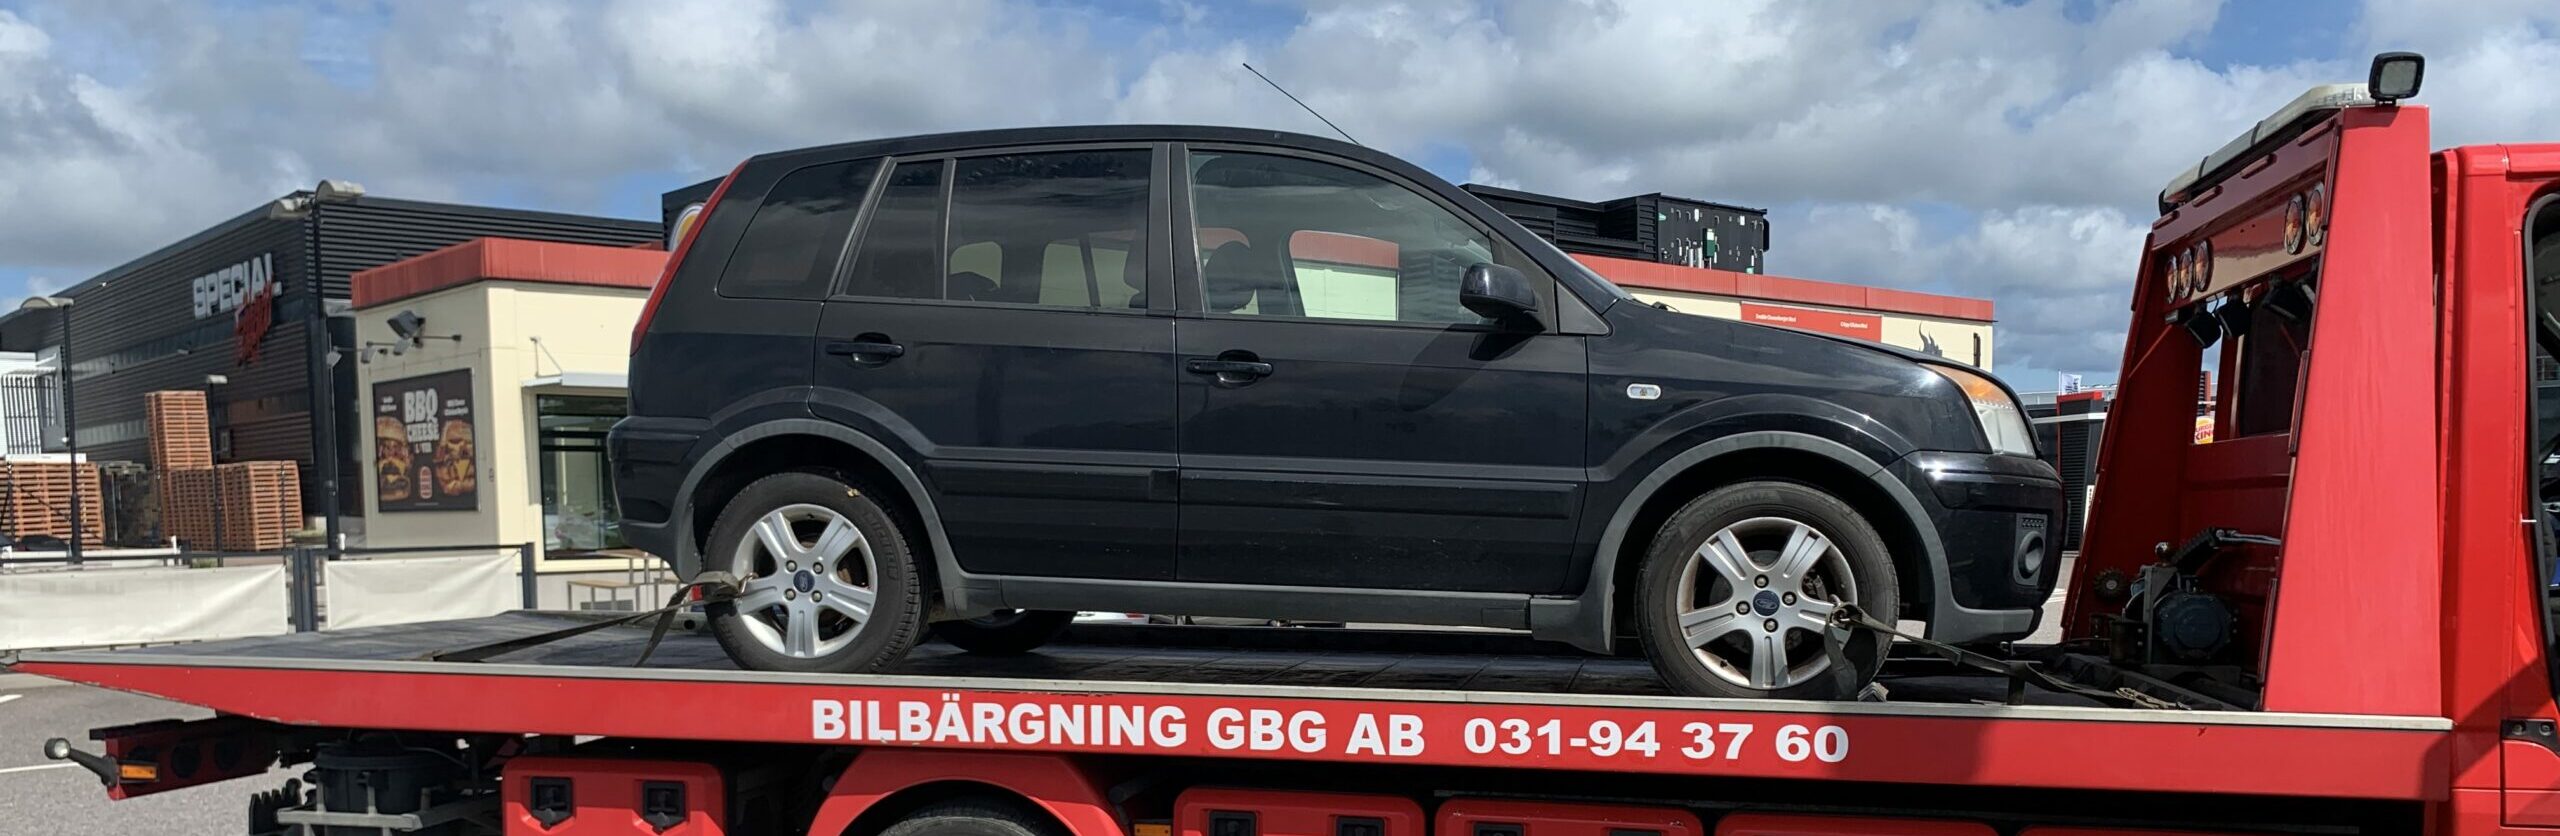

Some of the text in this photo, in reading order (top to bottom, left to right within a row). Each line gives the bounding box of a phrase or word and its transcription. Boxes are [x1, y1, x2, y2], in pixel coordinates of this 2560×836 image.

[193, 253, 282, 319] SPECIAL
[404, 388, 438, 424] BBQ
[407, 422, 440, 442] CHEESE
[812, 693, 1849, 763] BILBÄRGNING GBG AB 031-94 37 60
